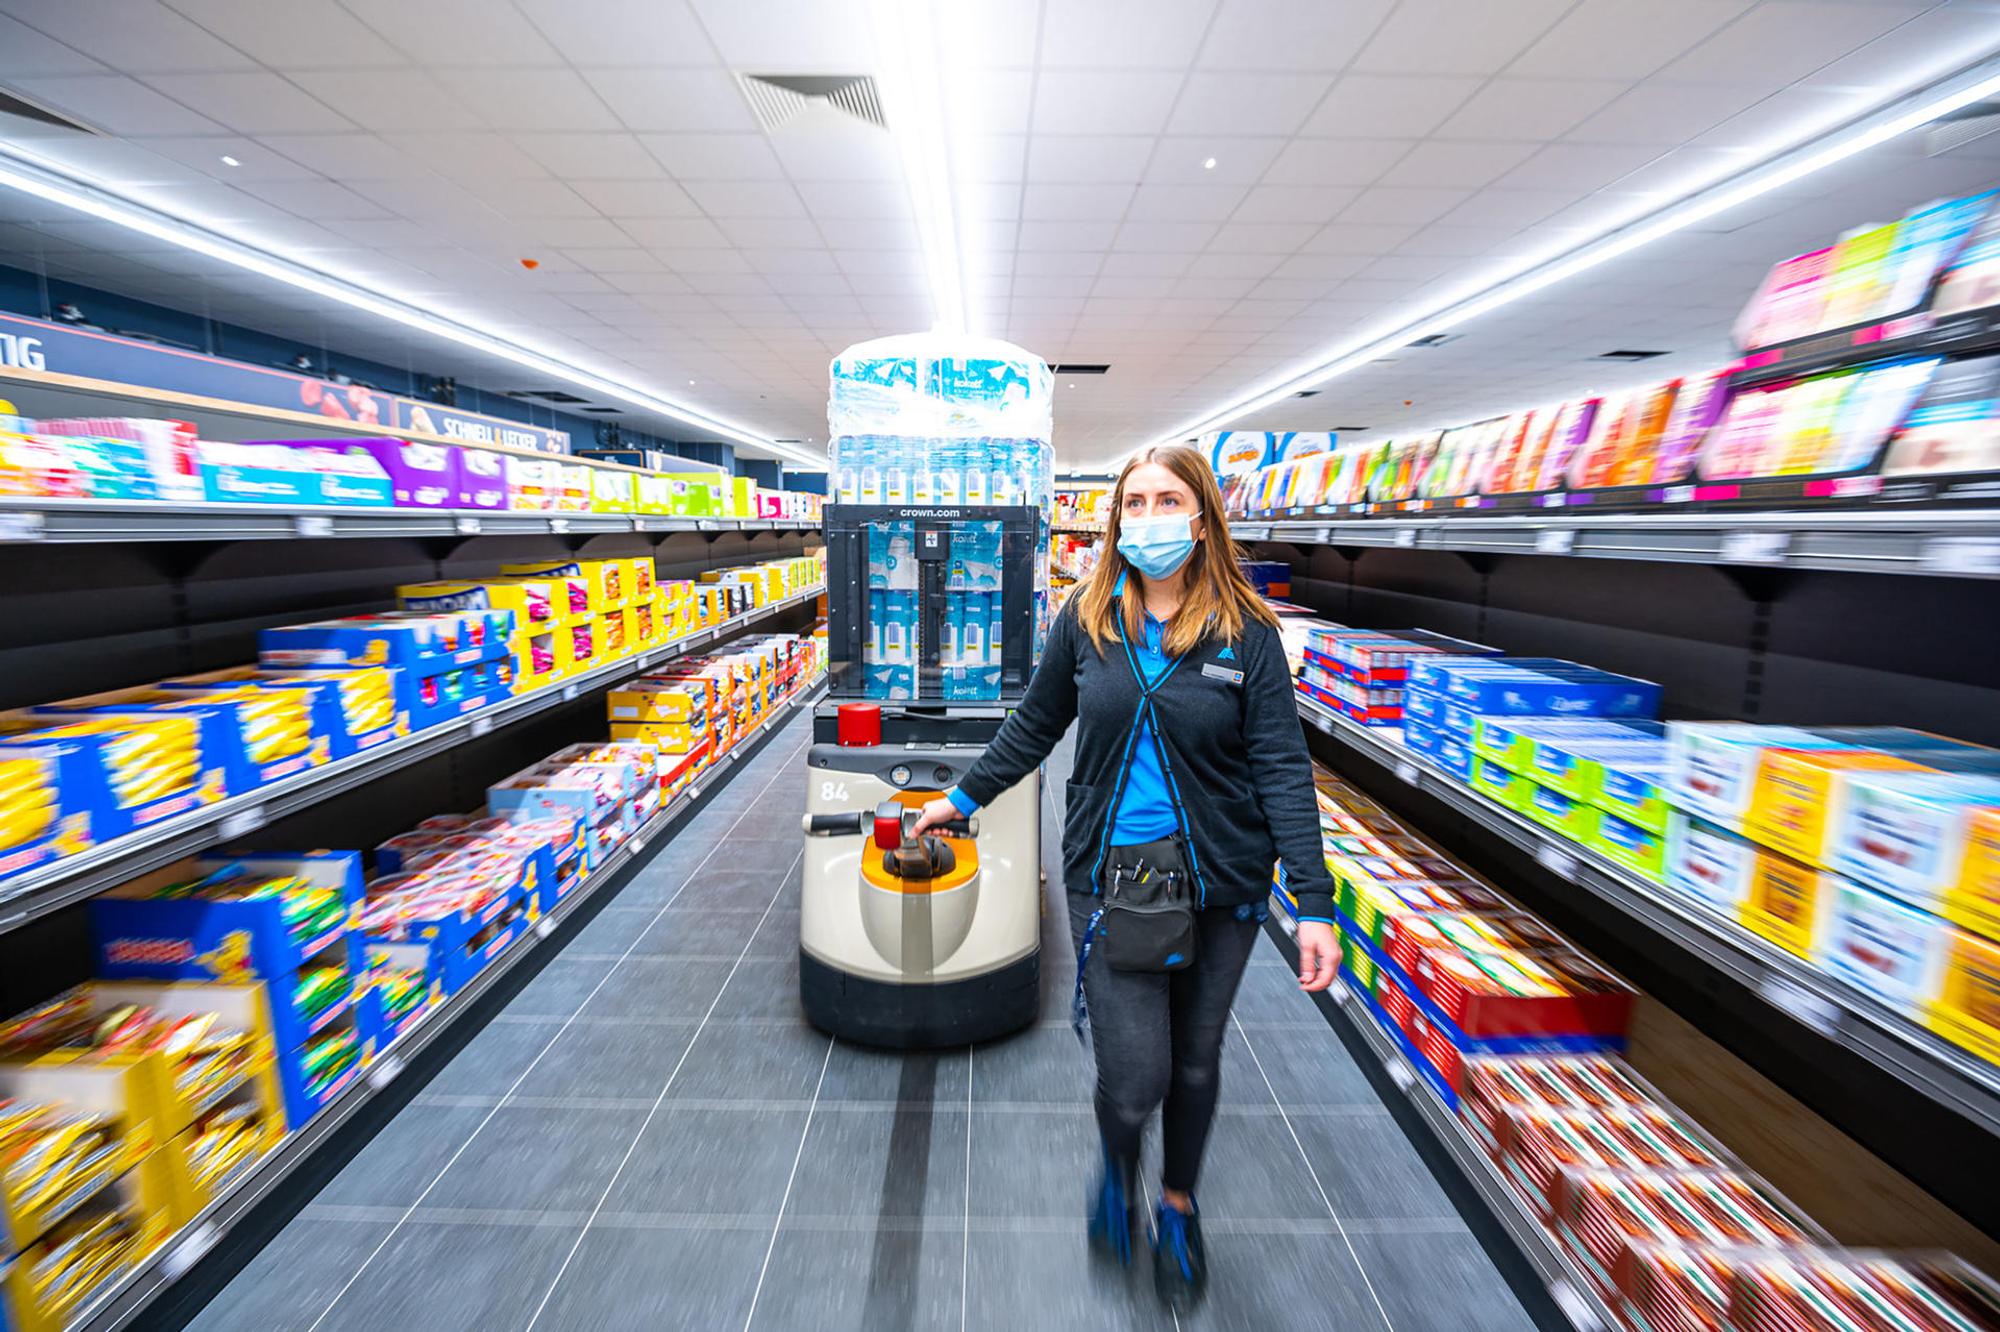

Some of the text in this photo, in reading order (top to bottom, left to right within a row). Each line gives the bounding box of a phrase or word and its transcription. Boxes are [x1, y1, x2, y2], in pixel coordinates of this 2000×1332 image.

[503, 431, 538, 449] LECKER
[900, 509, 960, 518] crown.com
[821, 781, 849, 801] 84
